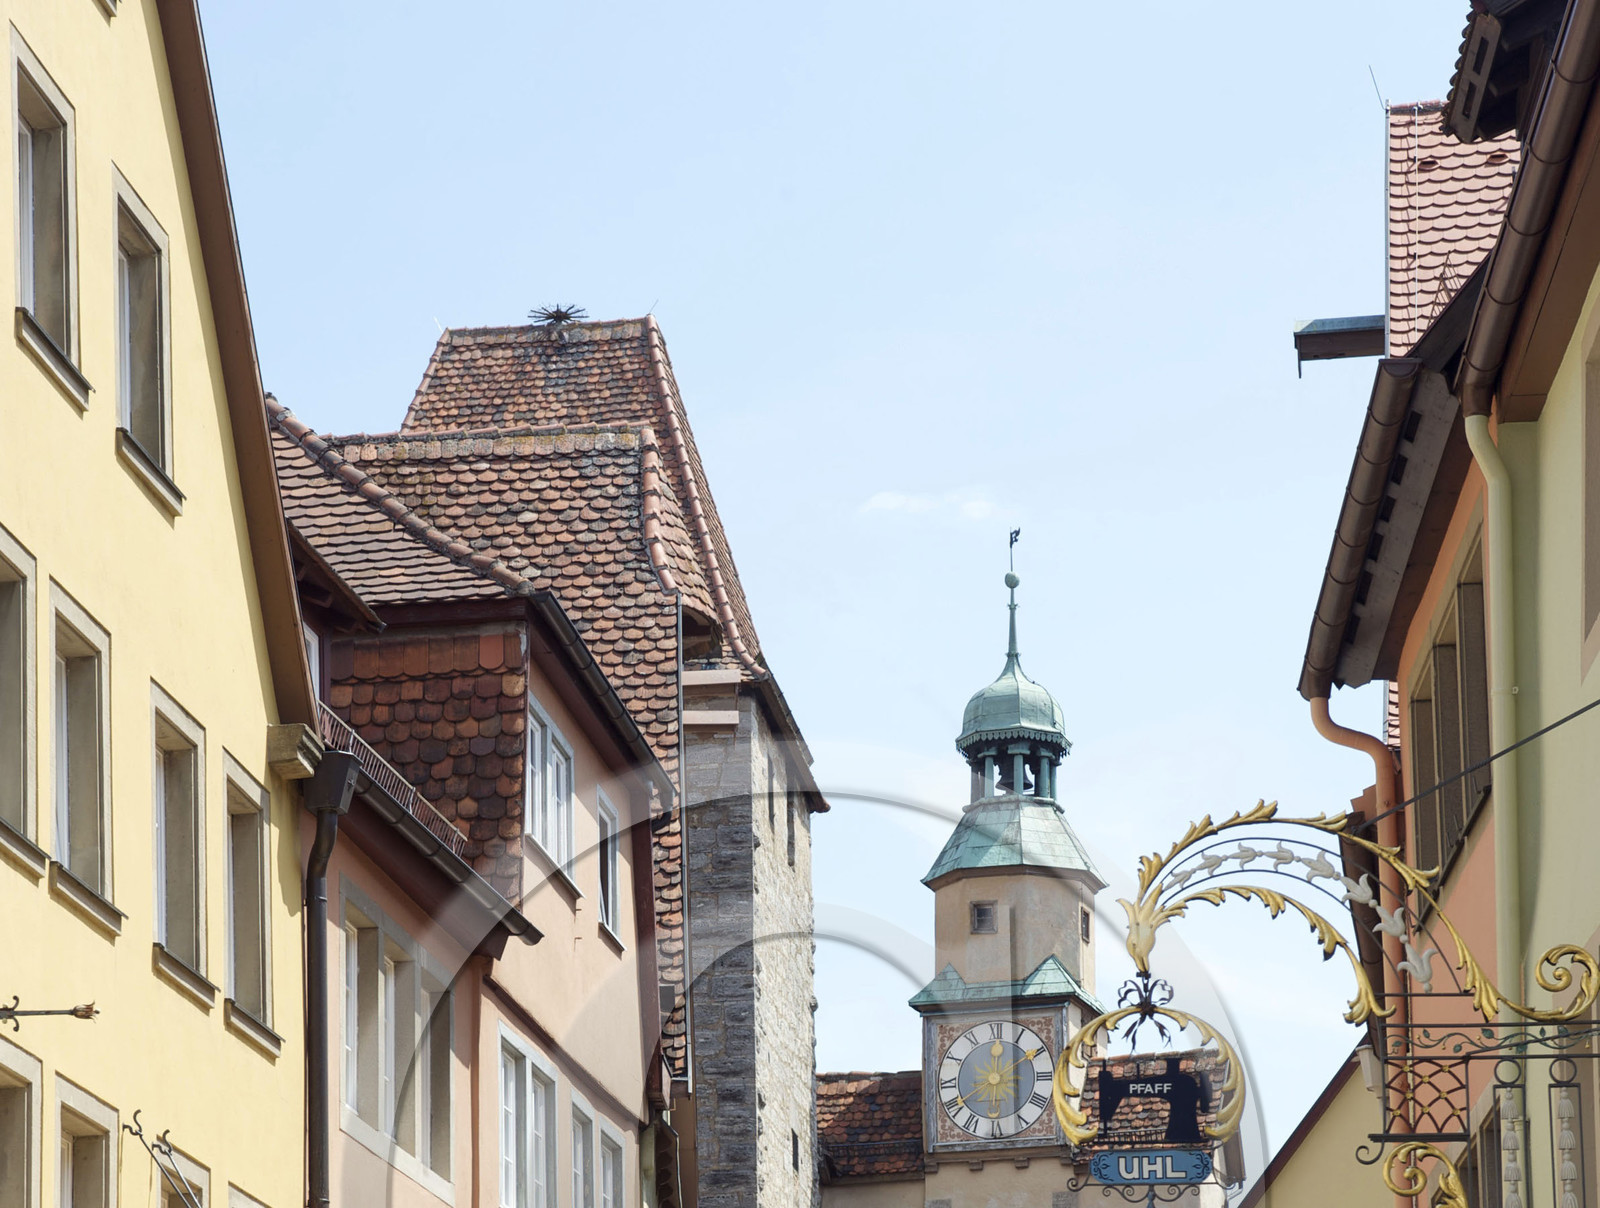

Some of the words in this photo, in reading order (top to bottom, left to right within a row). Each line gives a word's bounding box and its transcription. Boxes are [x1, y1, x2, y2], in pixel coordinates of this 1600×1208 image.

[989, 1023, 1004, 1040] XII
[1014, 1028, 1026, 1044] I
[963, 1031, 979, 1049] XI
[946, 1051, 962, 1065] X
[941, 1077, 957, 1090] IX
[1036, 1071, 1053, 1081] III
[1129, 1083, 1172, 1094] PFAFF
[991, 1120, 1003, 1137] VI
[1017, 1114, 1030, 1129] V
[1117, 1156, 1186, 1179] UHL
